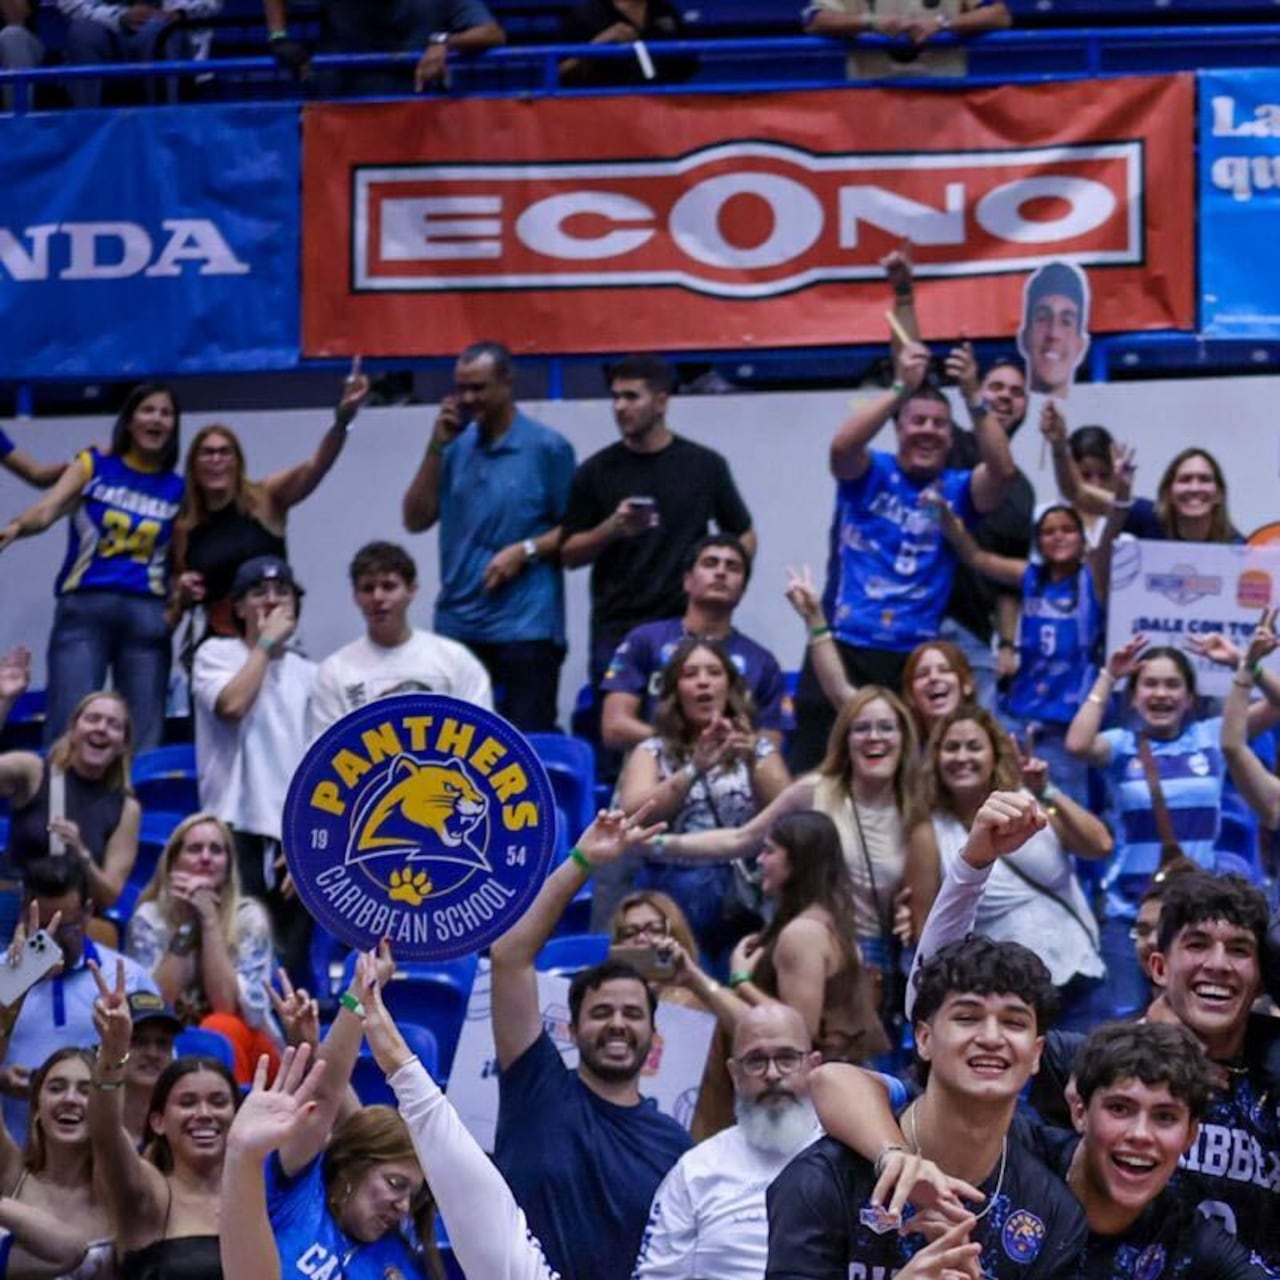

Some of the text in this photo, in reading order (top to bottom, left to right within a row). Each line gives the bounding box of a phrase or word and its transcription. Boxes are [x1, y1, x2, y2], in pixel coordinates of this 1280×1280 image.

[380, 171, 1116, 269] ECONO
[310, 715, 539, 831] PANTHERS
[311, 829, 328, 849] 19
[506, 845, 526, 867] 54
[315, 865, 517, 944] CARIBBEAN SCHOOL
